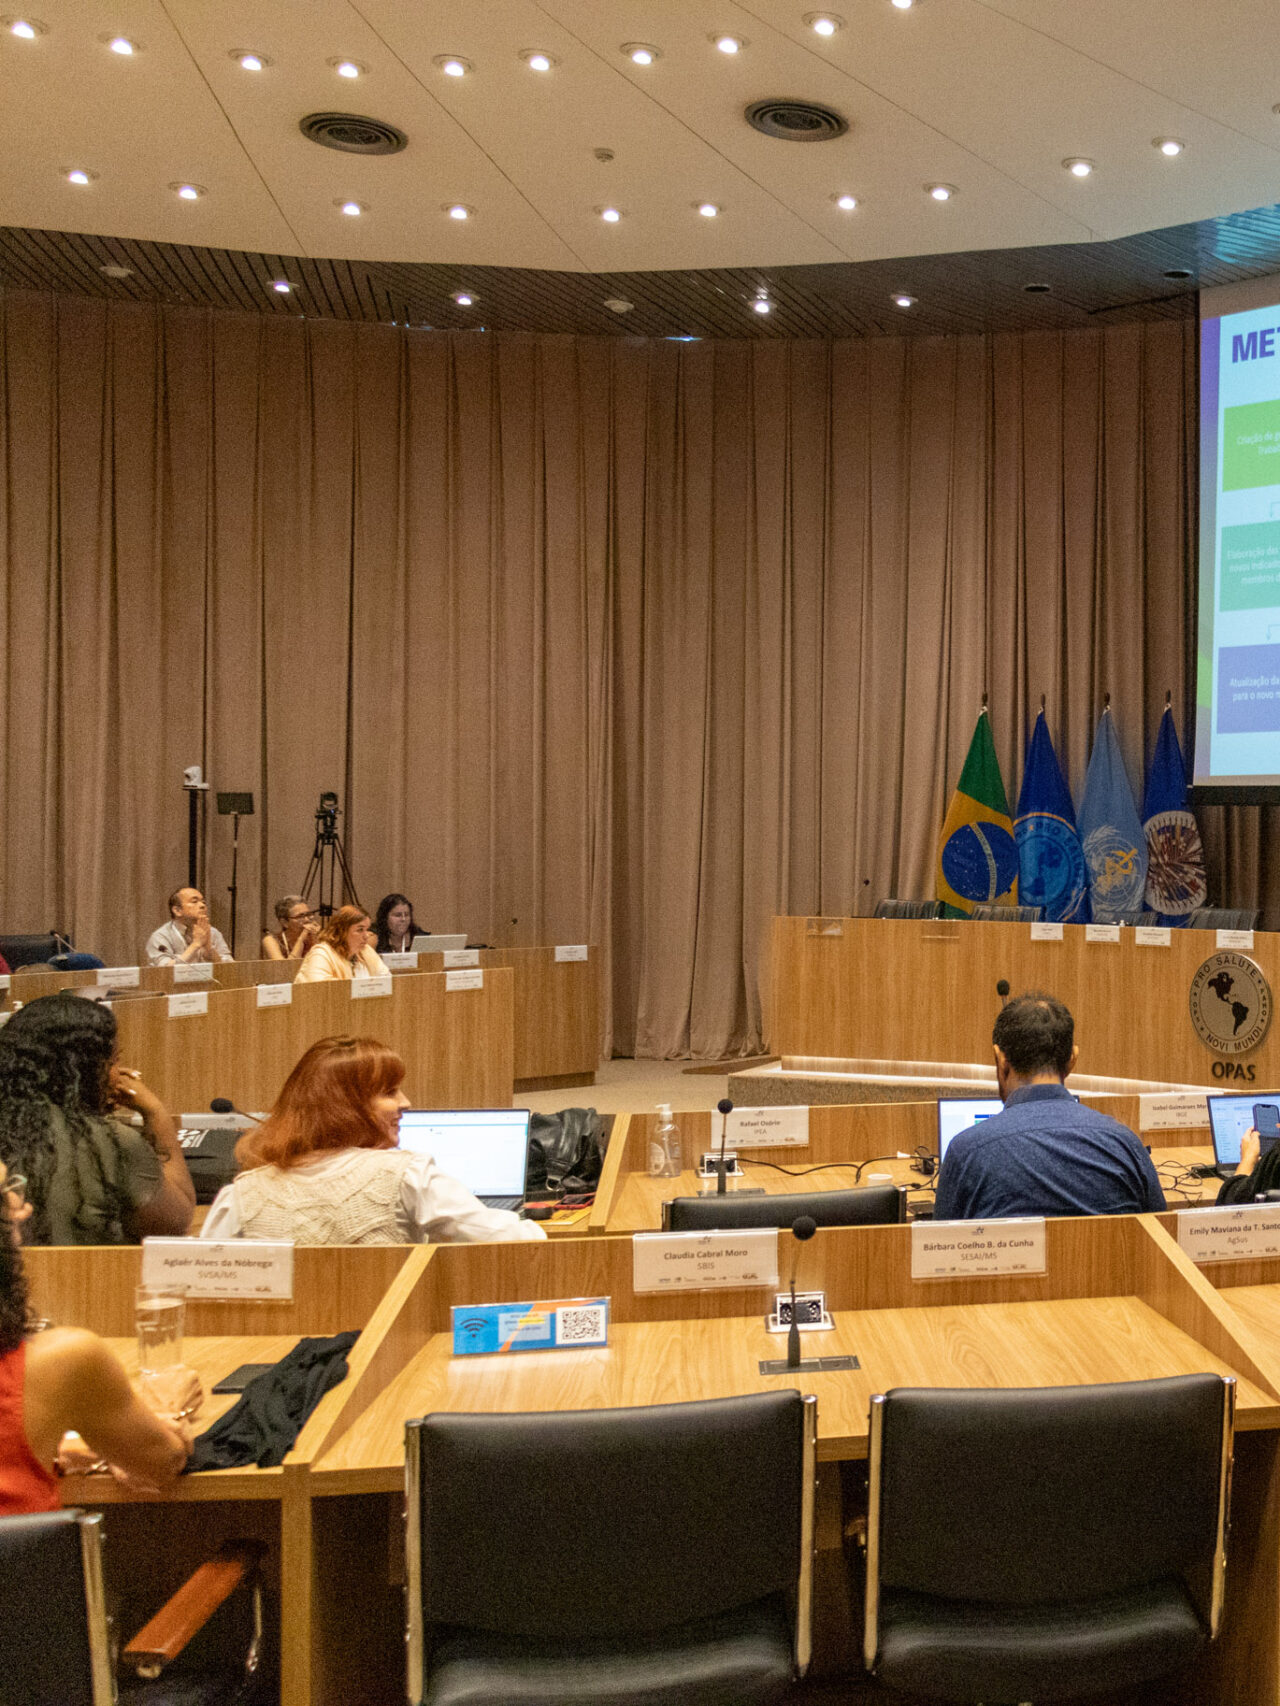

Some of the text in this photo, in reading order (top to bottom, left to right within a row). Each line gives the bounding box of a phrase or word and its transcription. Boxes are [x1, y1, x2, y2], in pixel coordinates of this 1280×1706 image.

[1230, 675, 1270, 688] Atualização
[1232, 692, 1249, 703] para
[1256, 691, 1274, 700] novo
[1194, 955, 1258, 989] PRO SALUTE
[1206, 1026, 1263, 1052] NOVI MUNDI
[1211, 1061, 1256, 1081] OPAS
[1189, 1227, 1209, 1236] Emily
[1210, 1225, 1242, 1234] Maviana
[1243, 1224, 1252, 1232] da
[923, 1238, 1034, 1251] Bárbara Coelho B. da Cunha
[664, 1248, 748, 1261] Claudia Cabral Moro
[960, 1251, 998, 1261] SESAI/MS
[194, 1257, 219, 1267] Alves
[221, 1258, 232, 1267] da
[234, 1258, 273, 1269] Nóbrega
